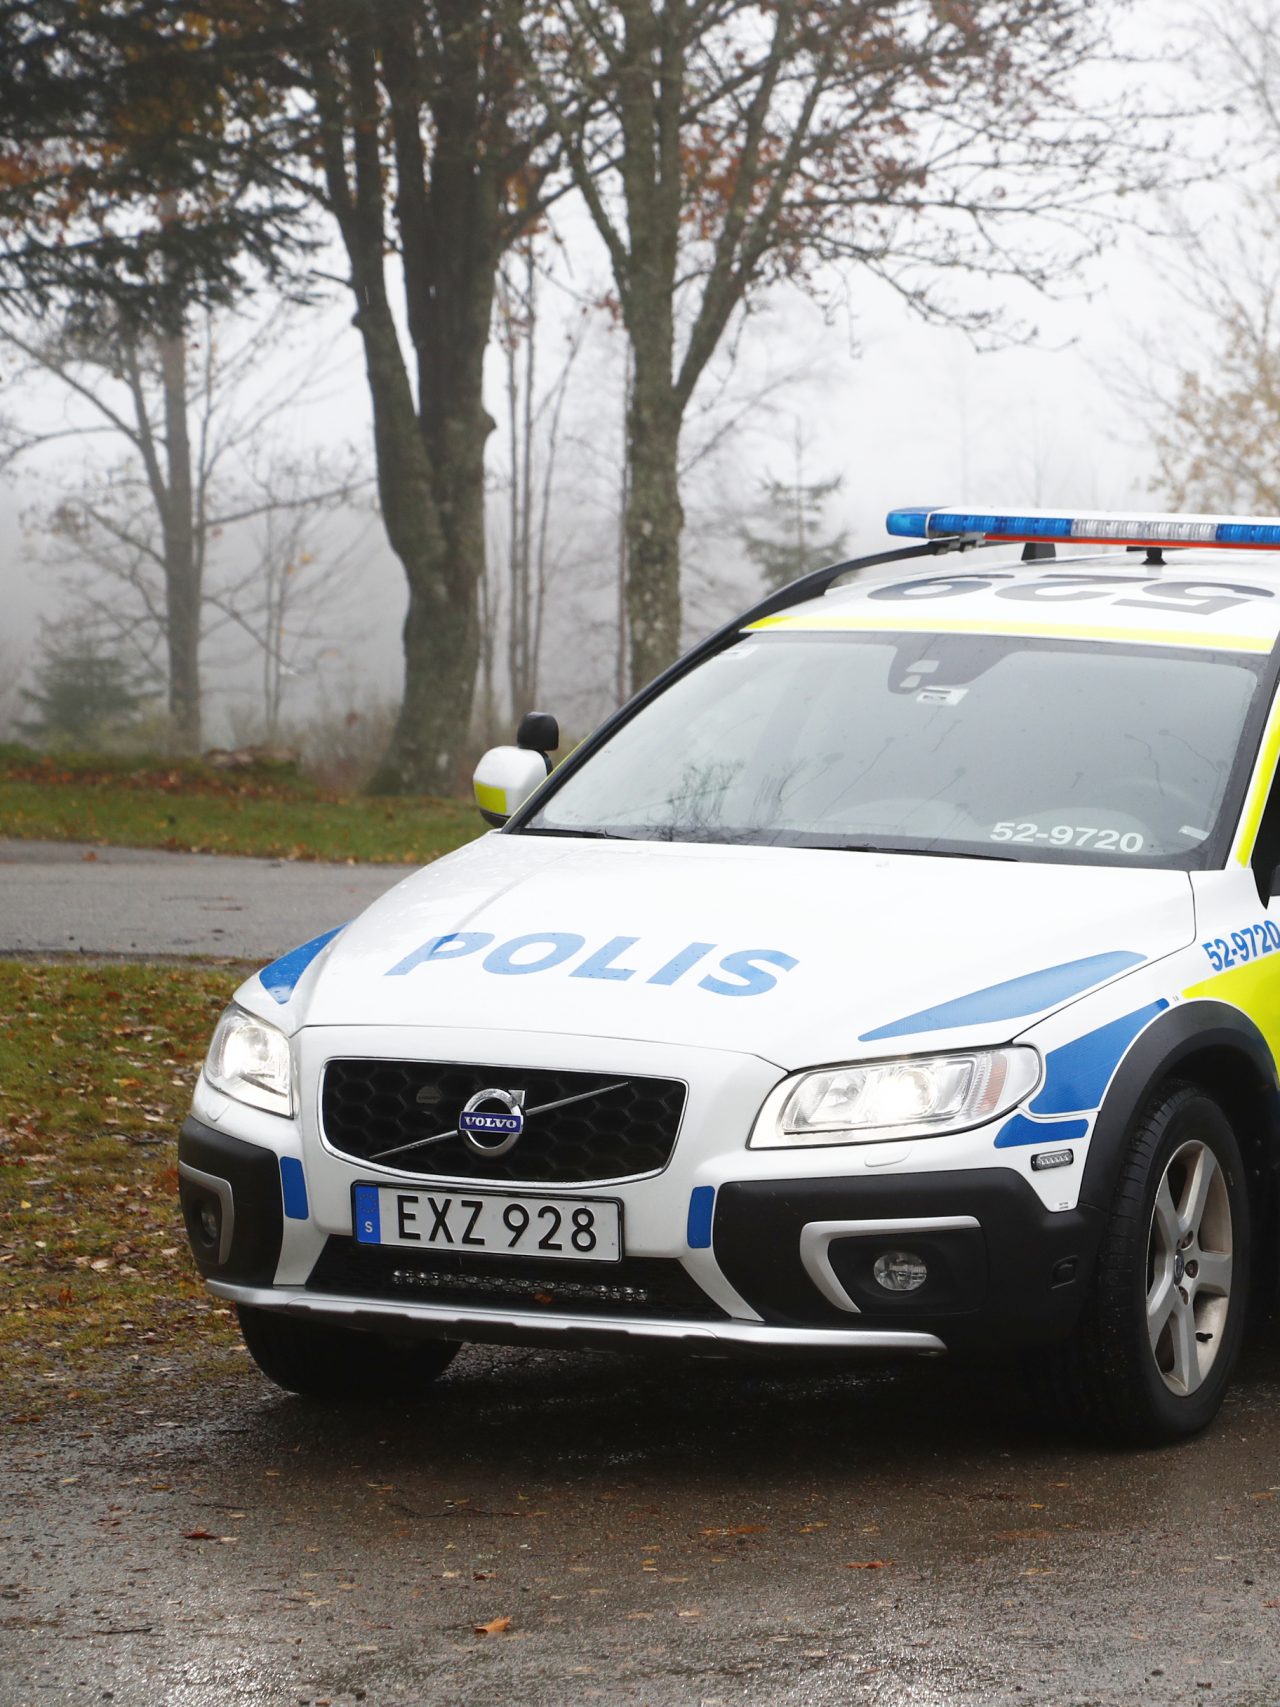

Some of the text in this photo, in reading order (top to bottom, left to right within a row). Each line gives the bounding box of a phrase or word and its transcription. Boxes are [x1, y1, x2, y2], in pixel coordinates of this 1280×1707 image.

[989, 821, 1144, 853] 52-9720
[383, 931, 800, 997] POLIS
[463, 1115, 518, 1130] VOLVO
[364, 1194, 597, 1253] S EXZ 928
